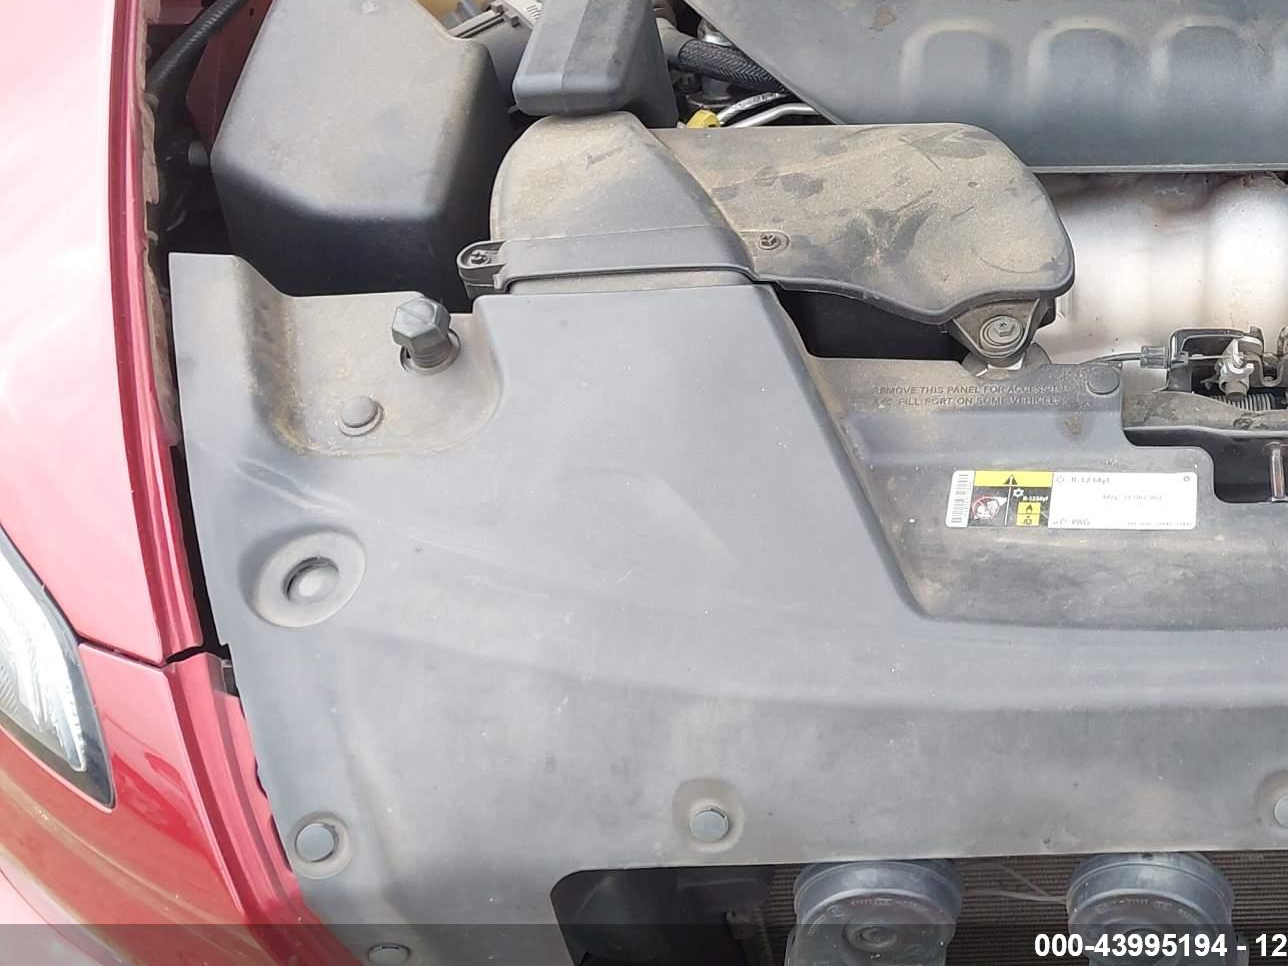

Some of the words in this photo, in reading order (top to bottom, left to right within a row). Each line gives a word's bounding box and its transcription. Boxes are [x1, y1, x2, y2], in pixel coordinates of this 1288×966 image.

[919, 385, 944, 395] THIS
[946, 385, 981, 395] PANEL
[983, 385, 1004, 394] FOR
[956, 396, 973, 405] ON
